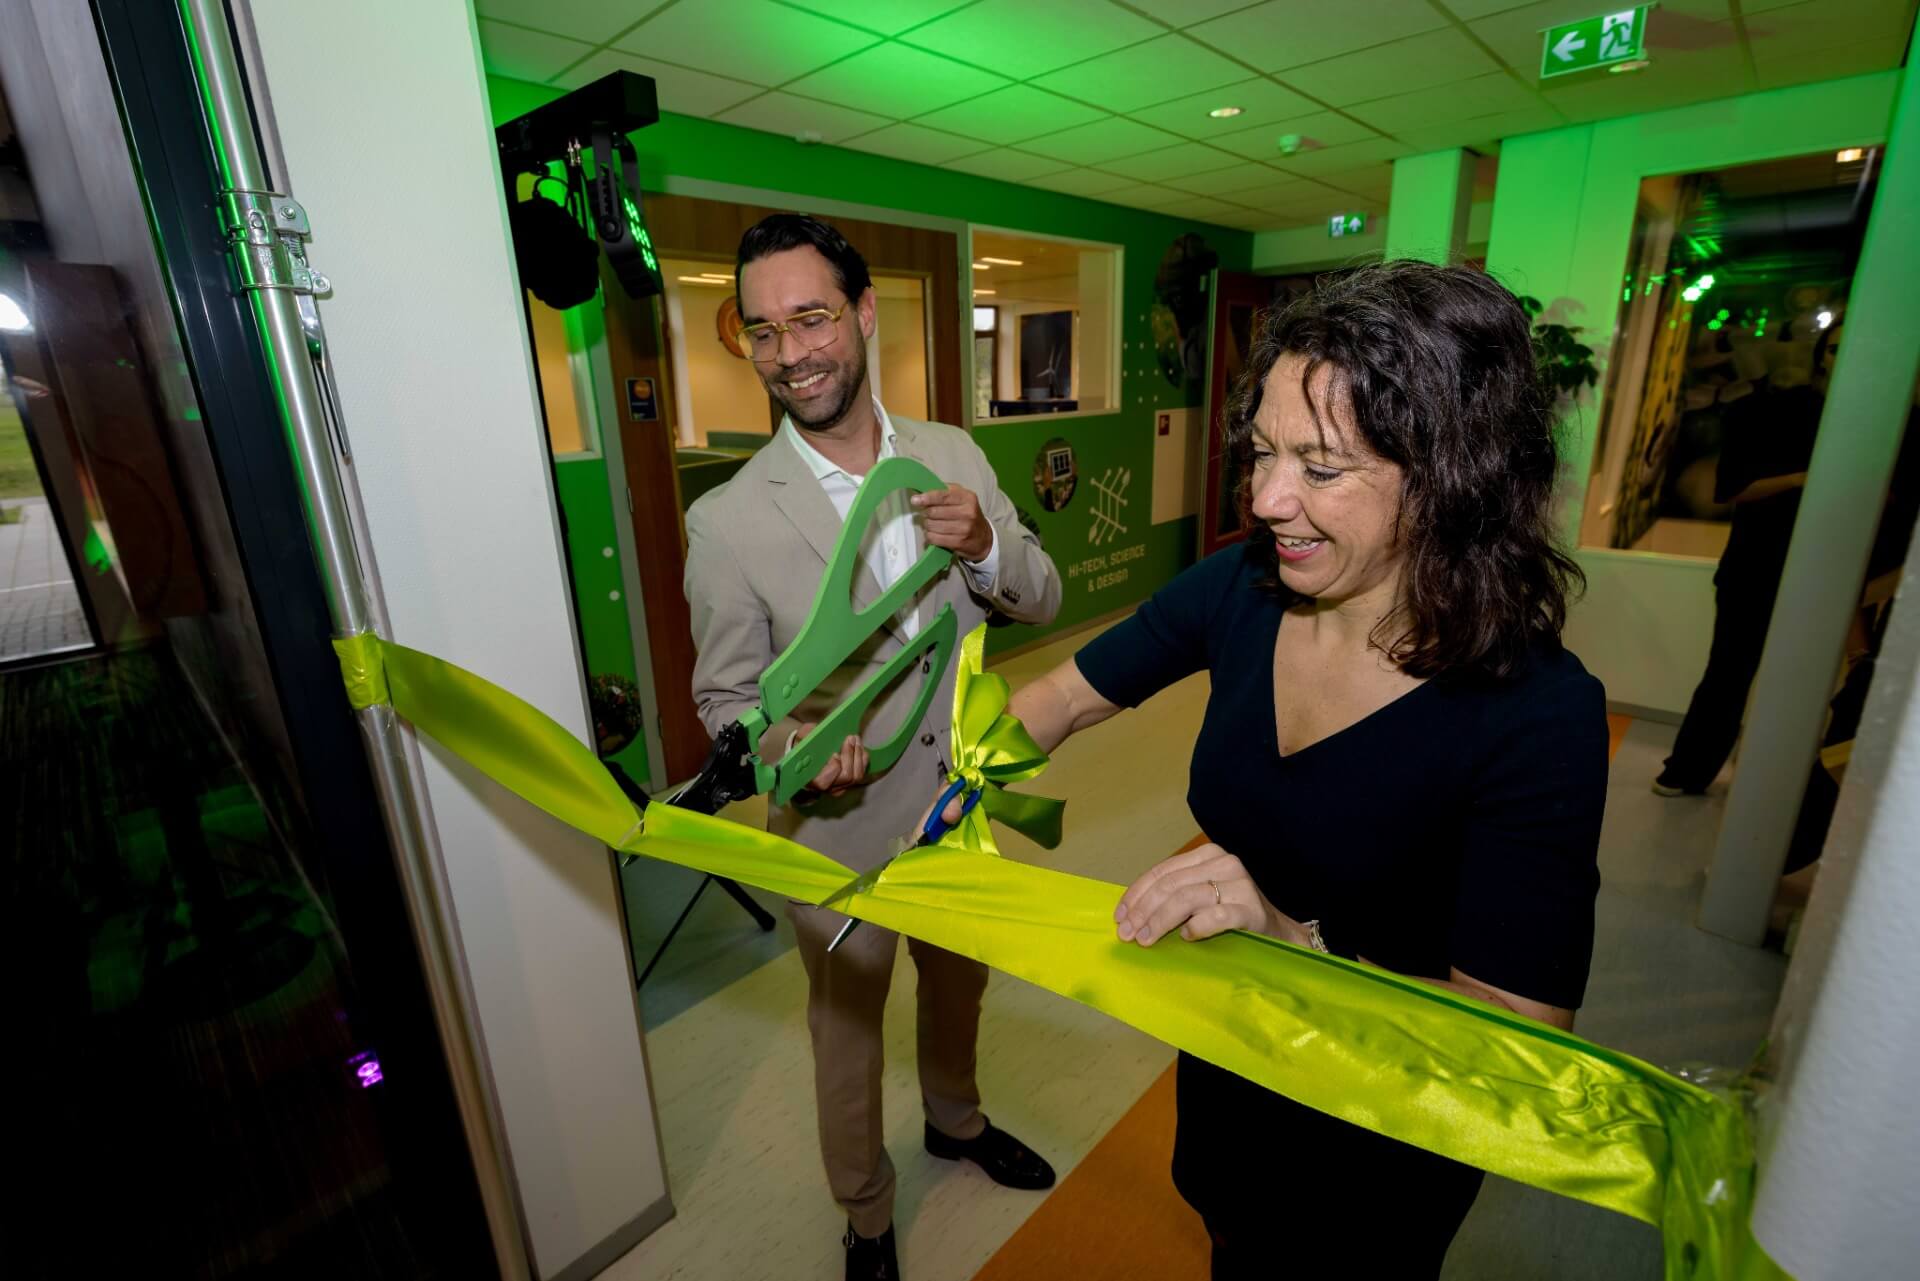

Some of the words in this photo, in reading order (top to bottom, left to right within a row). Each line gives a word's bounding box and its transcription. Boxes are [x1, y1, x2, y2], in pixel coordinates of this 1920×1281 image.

[1068, 555, 1107, 578] HI-TECH,
[1110, 544, 1145, 566] SCIENCE
[1087, 579, 1095, 592] &
[1097, 568, 1128, 590] DESIGN
